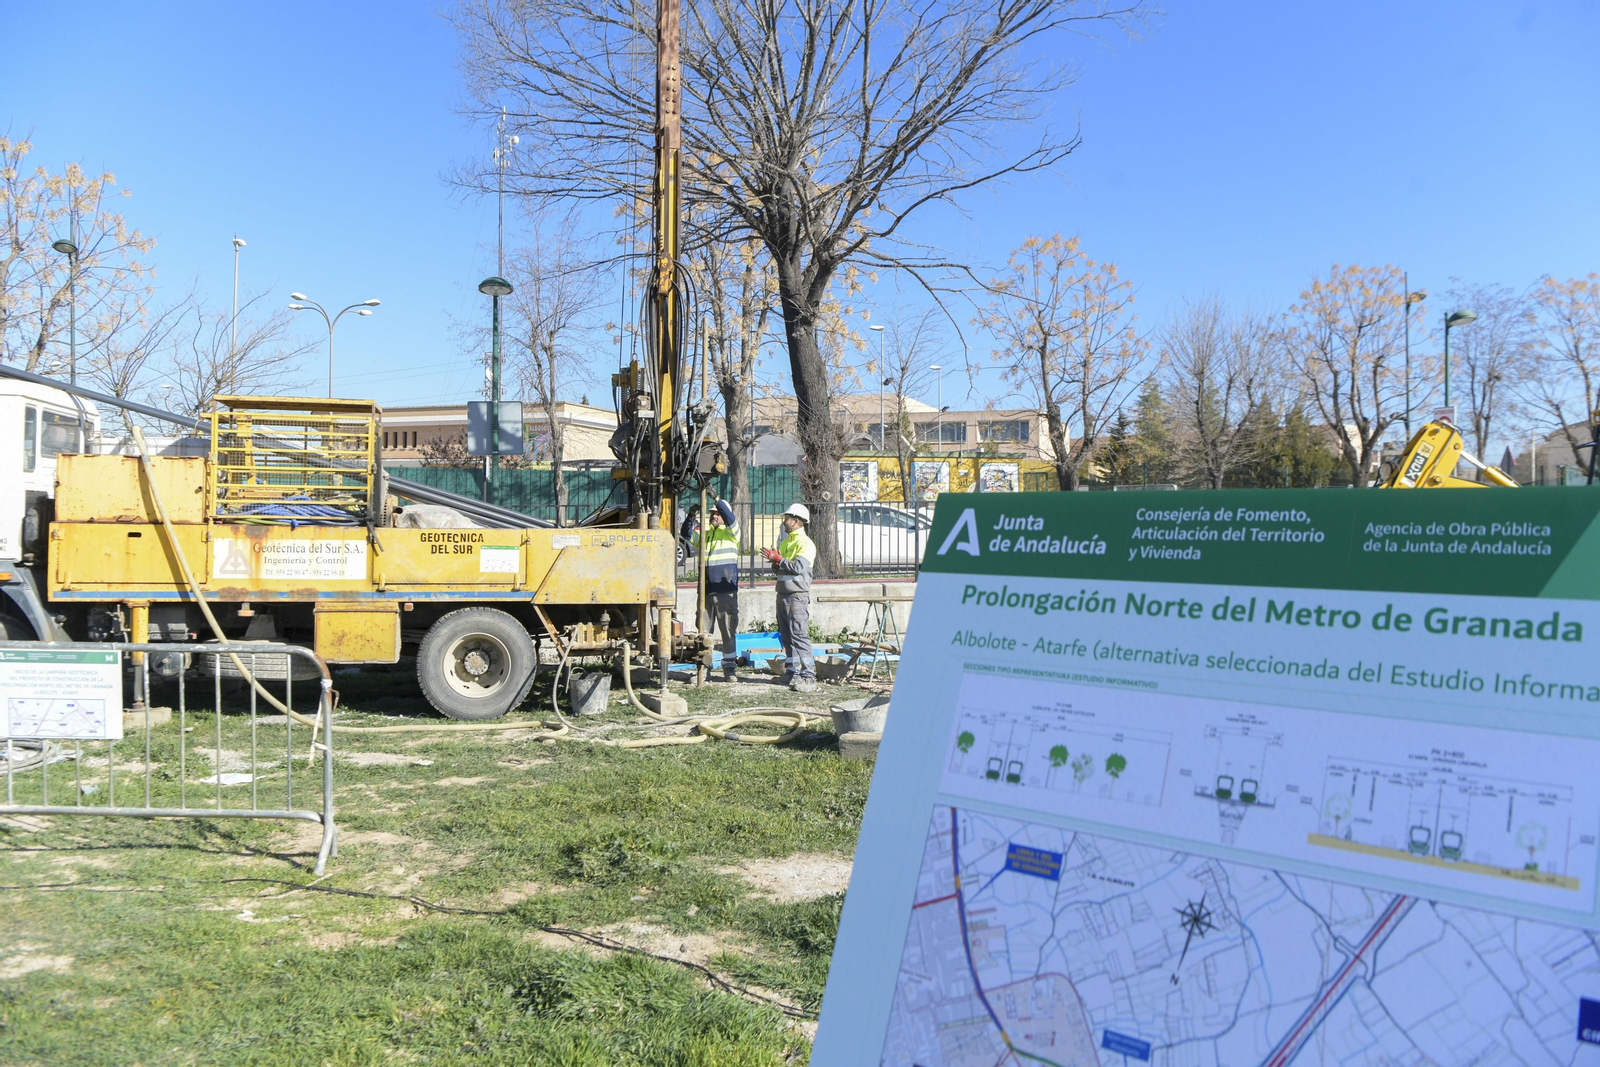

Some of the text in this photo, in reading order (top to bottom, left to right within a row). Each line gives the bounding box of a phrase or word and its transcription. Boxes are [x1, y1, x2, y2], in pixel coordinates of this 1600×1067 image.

[1406, 455, 1425, 480] 3CX
[993, 514, 1044, 531] Junta
[1136, 506, 1311, 525] Consejería de Fomento,
[420, 532, 484, 543] GEOTECNICA
[1131, 525, 1325, 543] Articulación del Territorio
[1364, 521, 1551, 538] Agencia de Obra Pública
[253, 542, 363, 554] Geotécnica del Sur S.A.
[431, 544, 473, 554] DEL SUR
[989, 534, 1107, 555] de Andalucía
[1128, 545, 1201, 561] y Vivienda
[1363, 538, 1552, 556] de la Junta de Andalucía
[264, 556, 306, 565] Ingeniería
[316, 556, 347, 564] Control
[961, 584, 1584, 643] Prolongación Norte del Metro de Granada
[951, 630, 1017, 650] Albolote
[1033, 637, 1087, 657] Atarfe
[1093, 639, 1199, 667] (alternativa
[1205, 651, 1340, 679] seleccionada
[1347, 661, 1383, 683] del
[1390, 665, 1485, 693] Estudio
[1494, 673, 1600, 702] Informa
[963, 662, 1158, 689] SECCIONES TIPO REPRESENTATIVAS (ESTUDIO INFORMATIVO)
